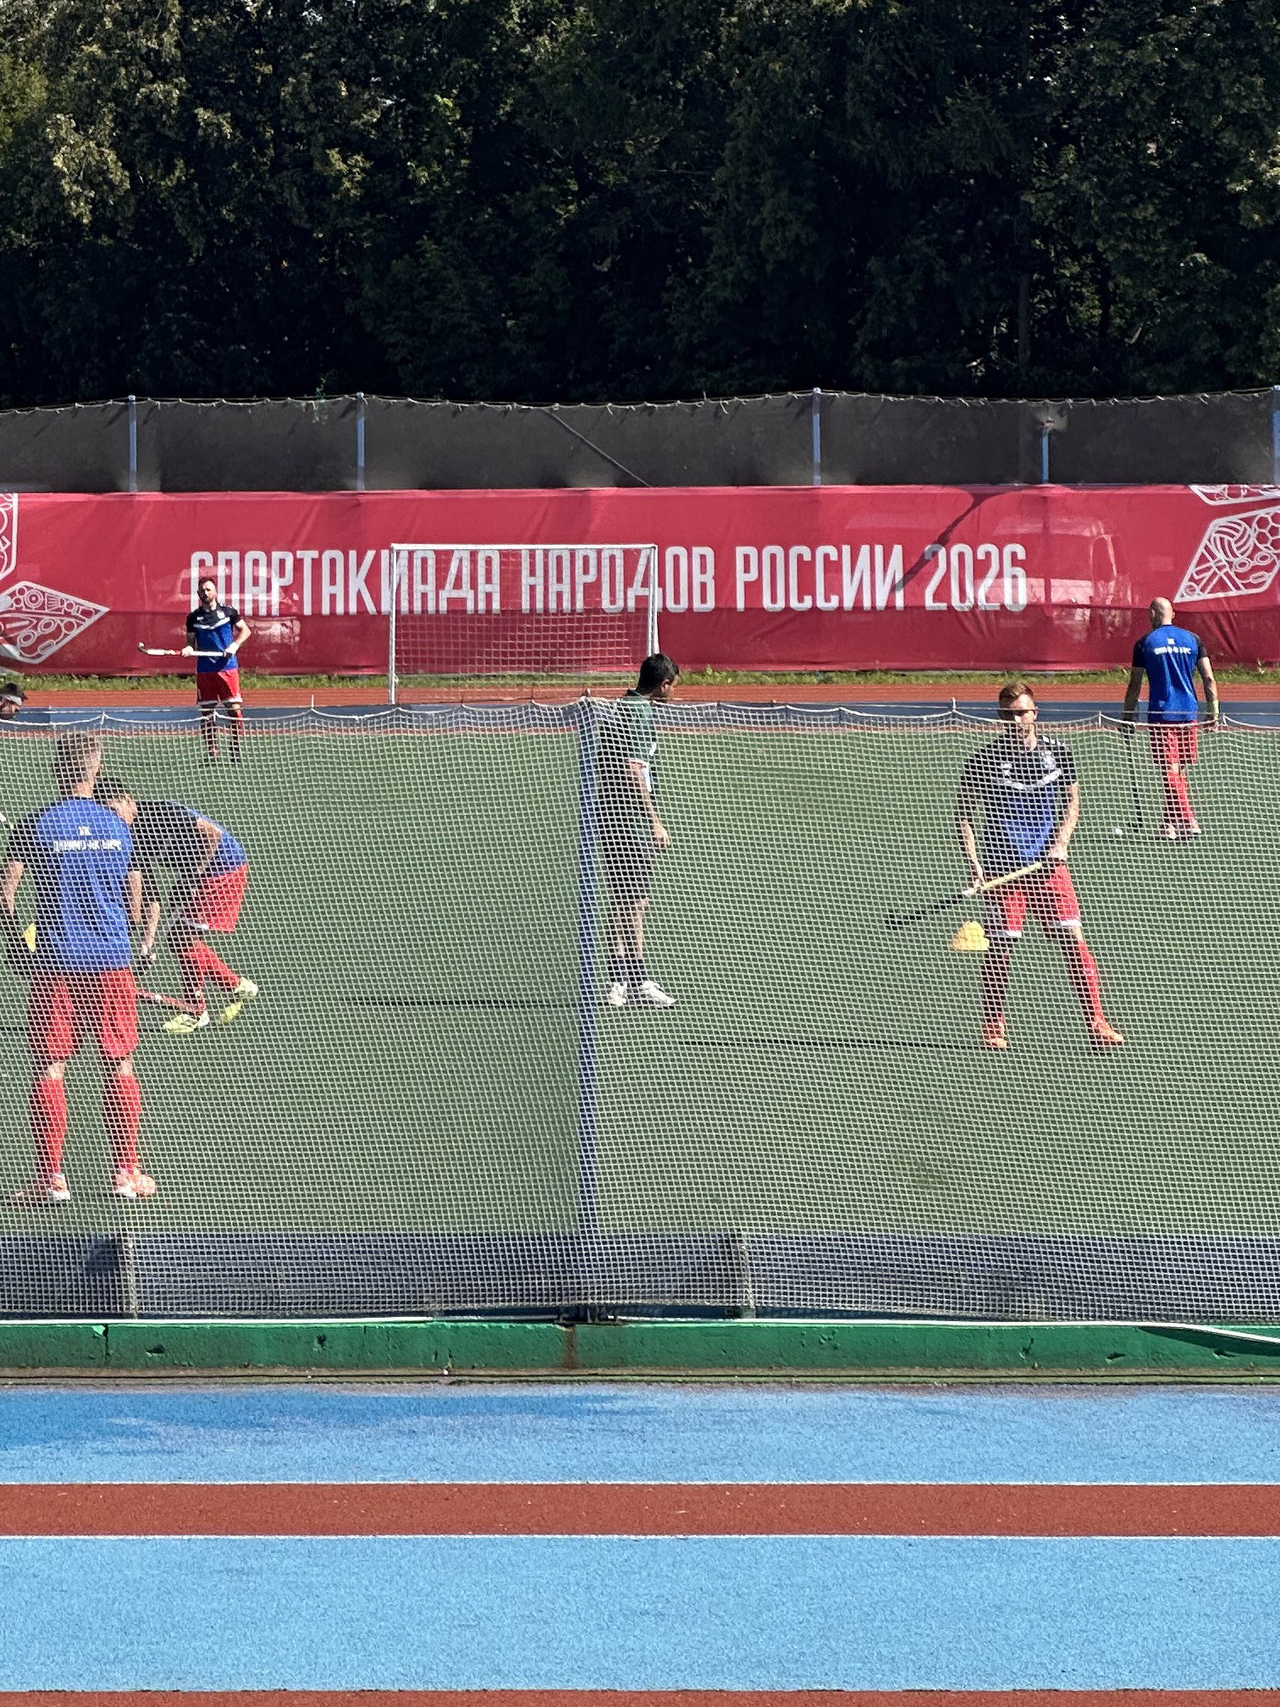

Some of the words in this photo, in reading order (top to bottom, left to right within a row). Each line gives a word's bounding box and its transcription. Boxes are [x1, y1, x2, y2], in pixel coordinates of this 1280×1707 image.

[190, 548, 500, 617] СПАРТАКИАДА
[521, 546, 716, 614] НАРОДОВ
[736, 544, 904, 613] РОССИИ
[924, 543, 1028, 612] 2026
